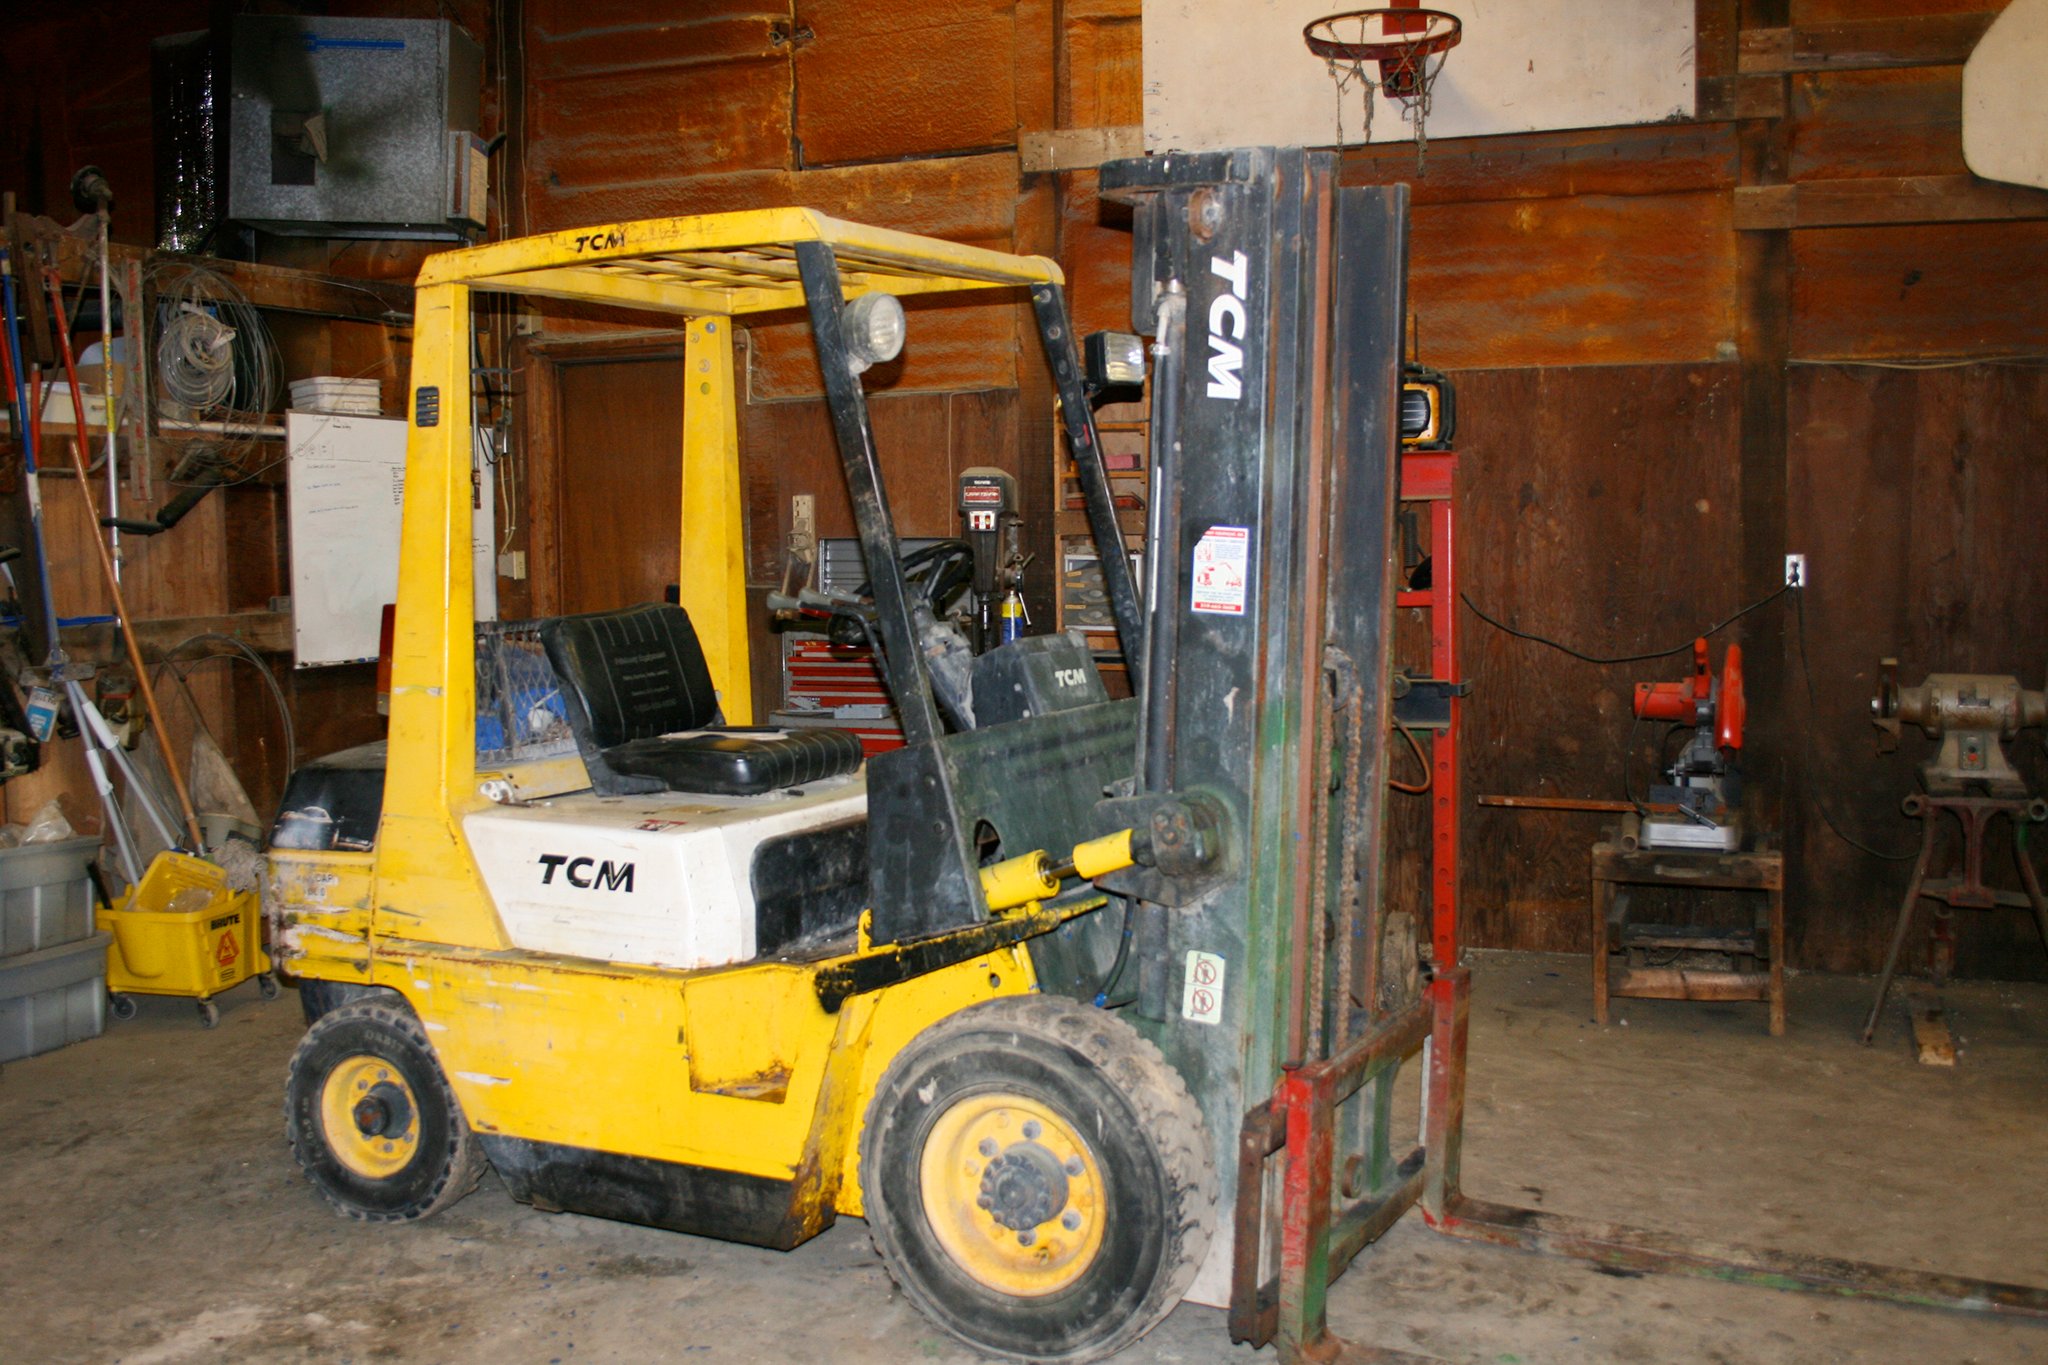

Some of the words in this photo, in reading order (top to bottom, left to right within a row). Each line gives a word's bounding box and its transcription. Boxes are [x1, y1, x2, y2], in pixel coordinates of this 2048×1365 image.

[576, 233, 625, 253] TCM
[1207, 250, 1248, 400] TCM
[1055, 668, 1087, 688] TCM
[538, 853, 635, 893] TCM
[210, 913, 240, 930] BRUTE
